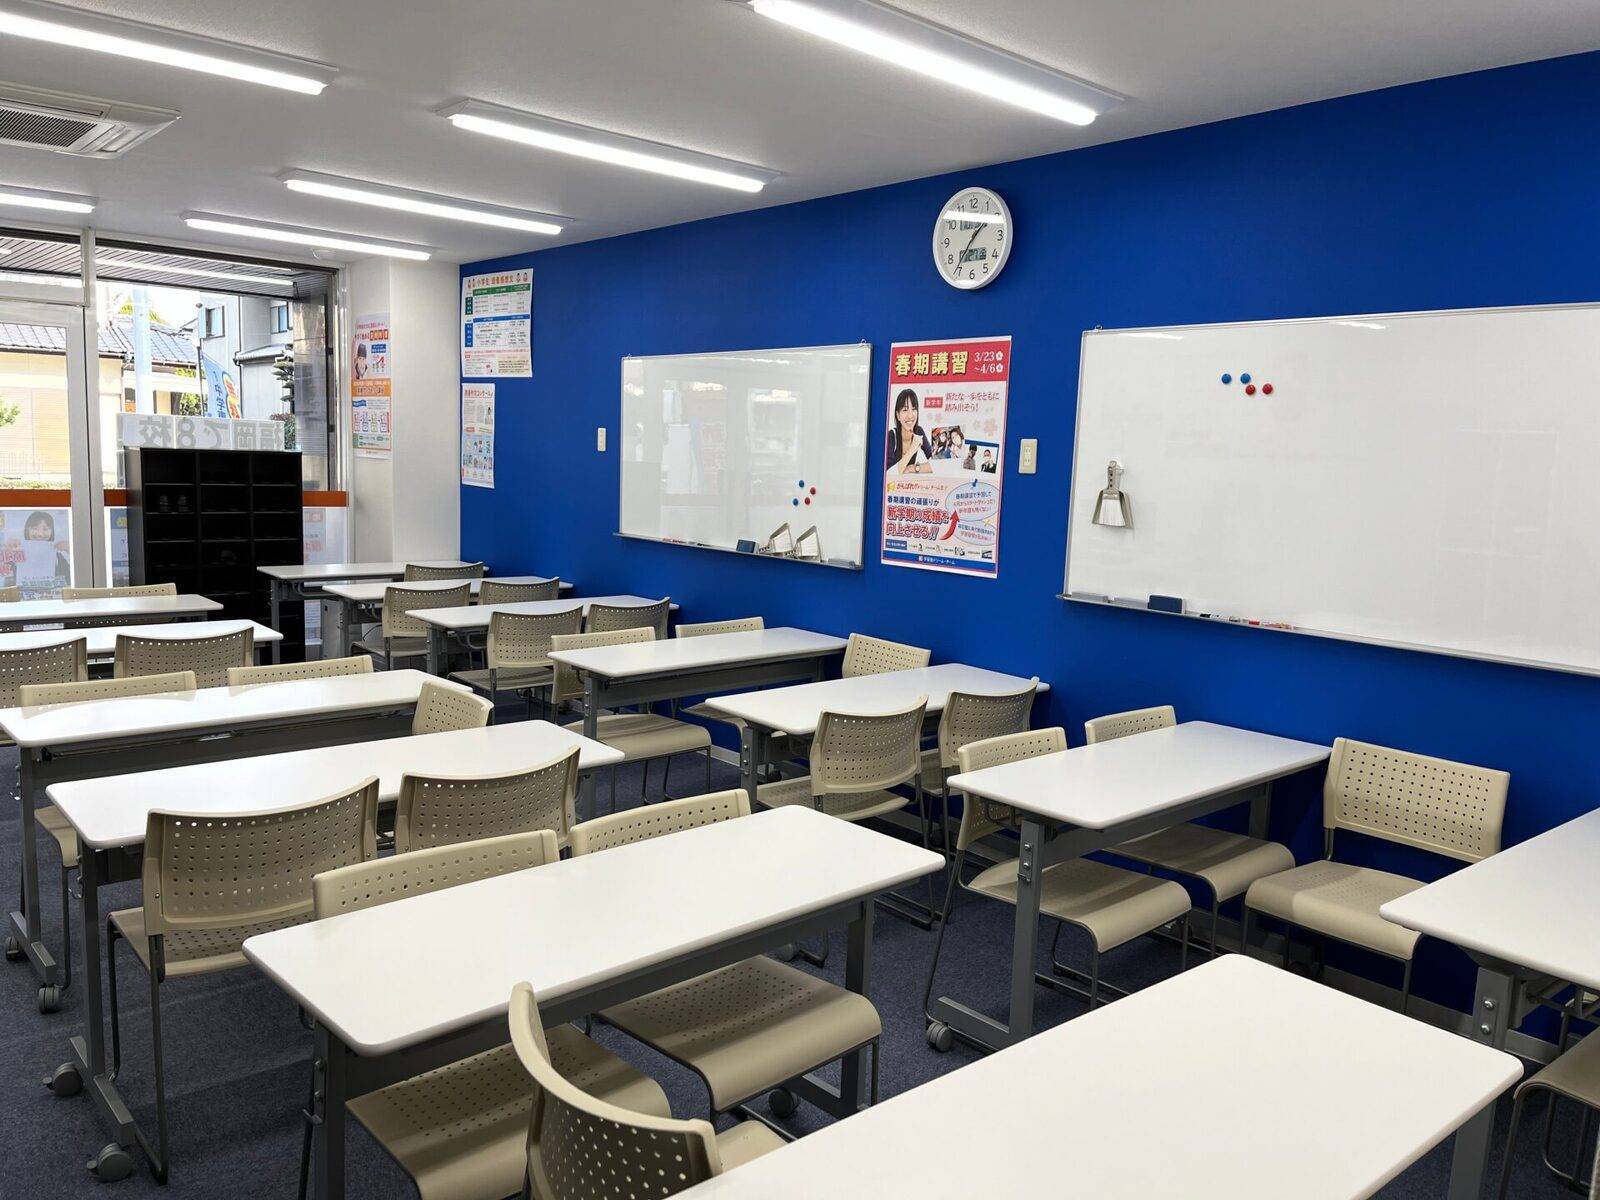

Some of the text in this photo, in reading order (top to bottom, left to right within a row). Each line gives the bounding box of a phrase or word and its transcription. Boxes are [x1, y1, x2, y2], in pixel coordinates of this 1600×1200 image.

[969, 198, 979, 209] 12
[985, 200, 990, 212] 1
[945, 220, 957, 230] 10
[997, 229, 1004, 241] 3
[943, 237, 950, 248] 9
[947, 254, 954, 264] 8
[991, 248, 999, 259] 4
[957, 266, 963, 277] 7
[982, 263, 989, 274] 5
[968, 269, 975, 280] 6
[974, 351, 995, 362] 3/23
[895, 351, 968, 376] 春期講習
[945, 392, 1000, 401] 新たな一歩をともに
[887, 505, 949, 525] 新学期の成績を
